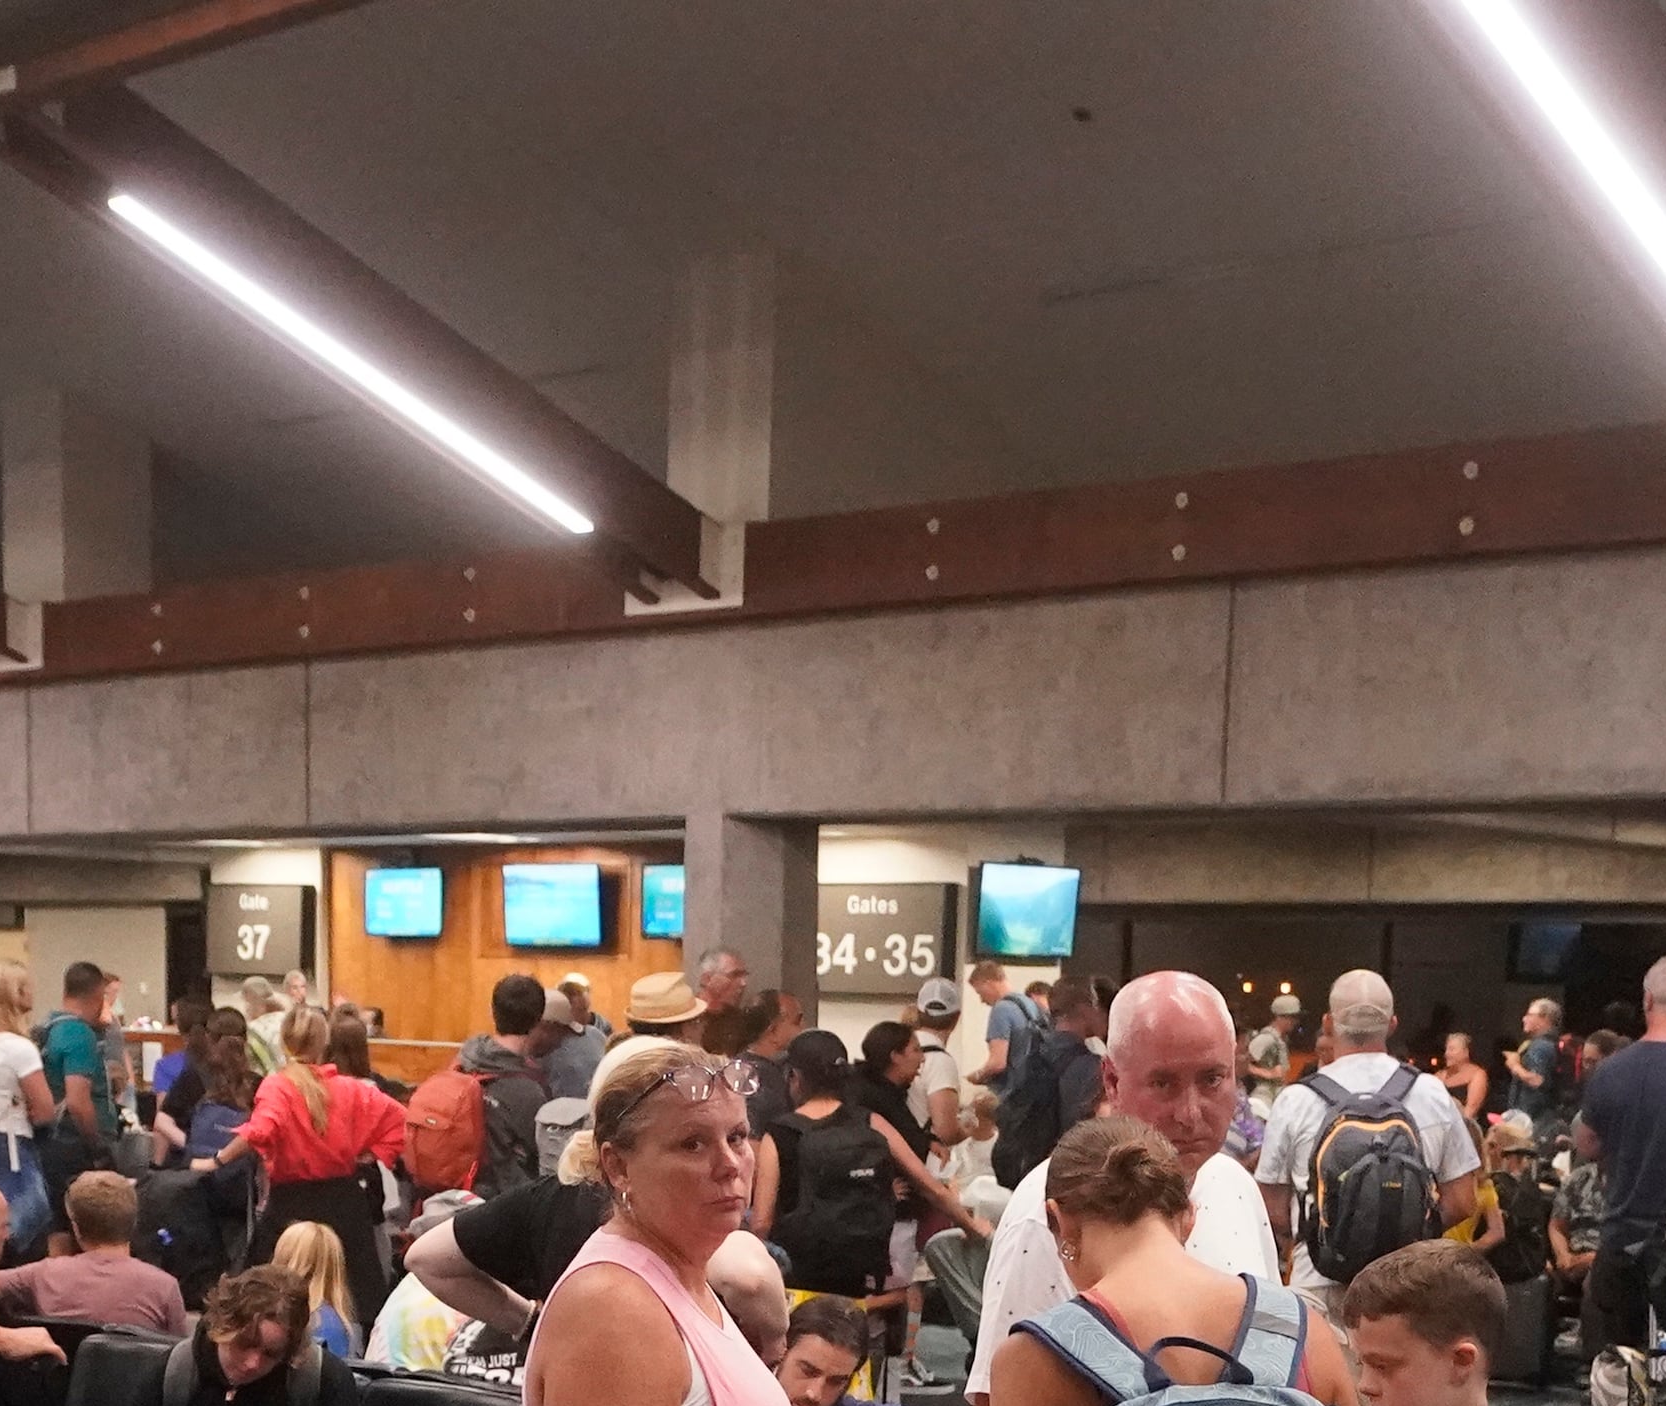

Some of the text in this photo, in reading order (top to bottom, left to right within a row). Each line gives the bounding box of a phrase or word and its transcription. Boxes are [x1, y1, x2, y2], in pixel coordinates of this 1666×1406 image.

[238, 893, 269, 911] Gate
[847, 894, 899, 915] Gates
[236, 923, 271, 961] 37
[488, 1352, 518, 1369] JUST
